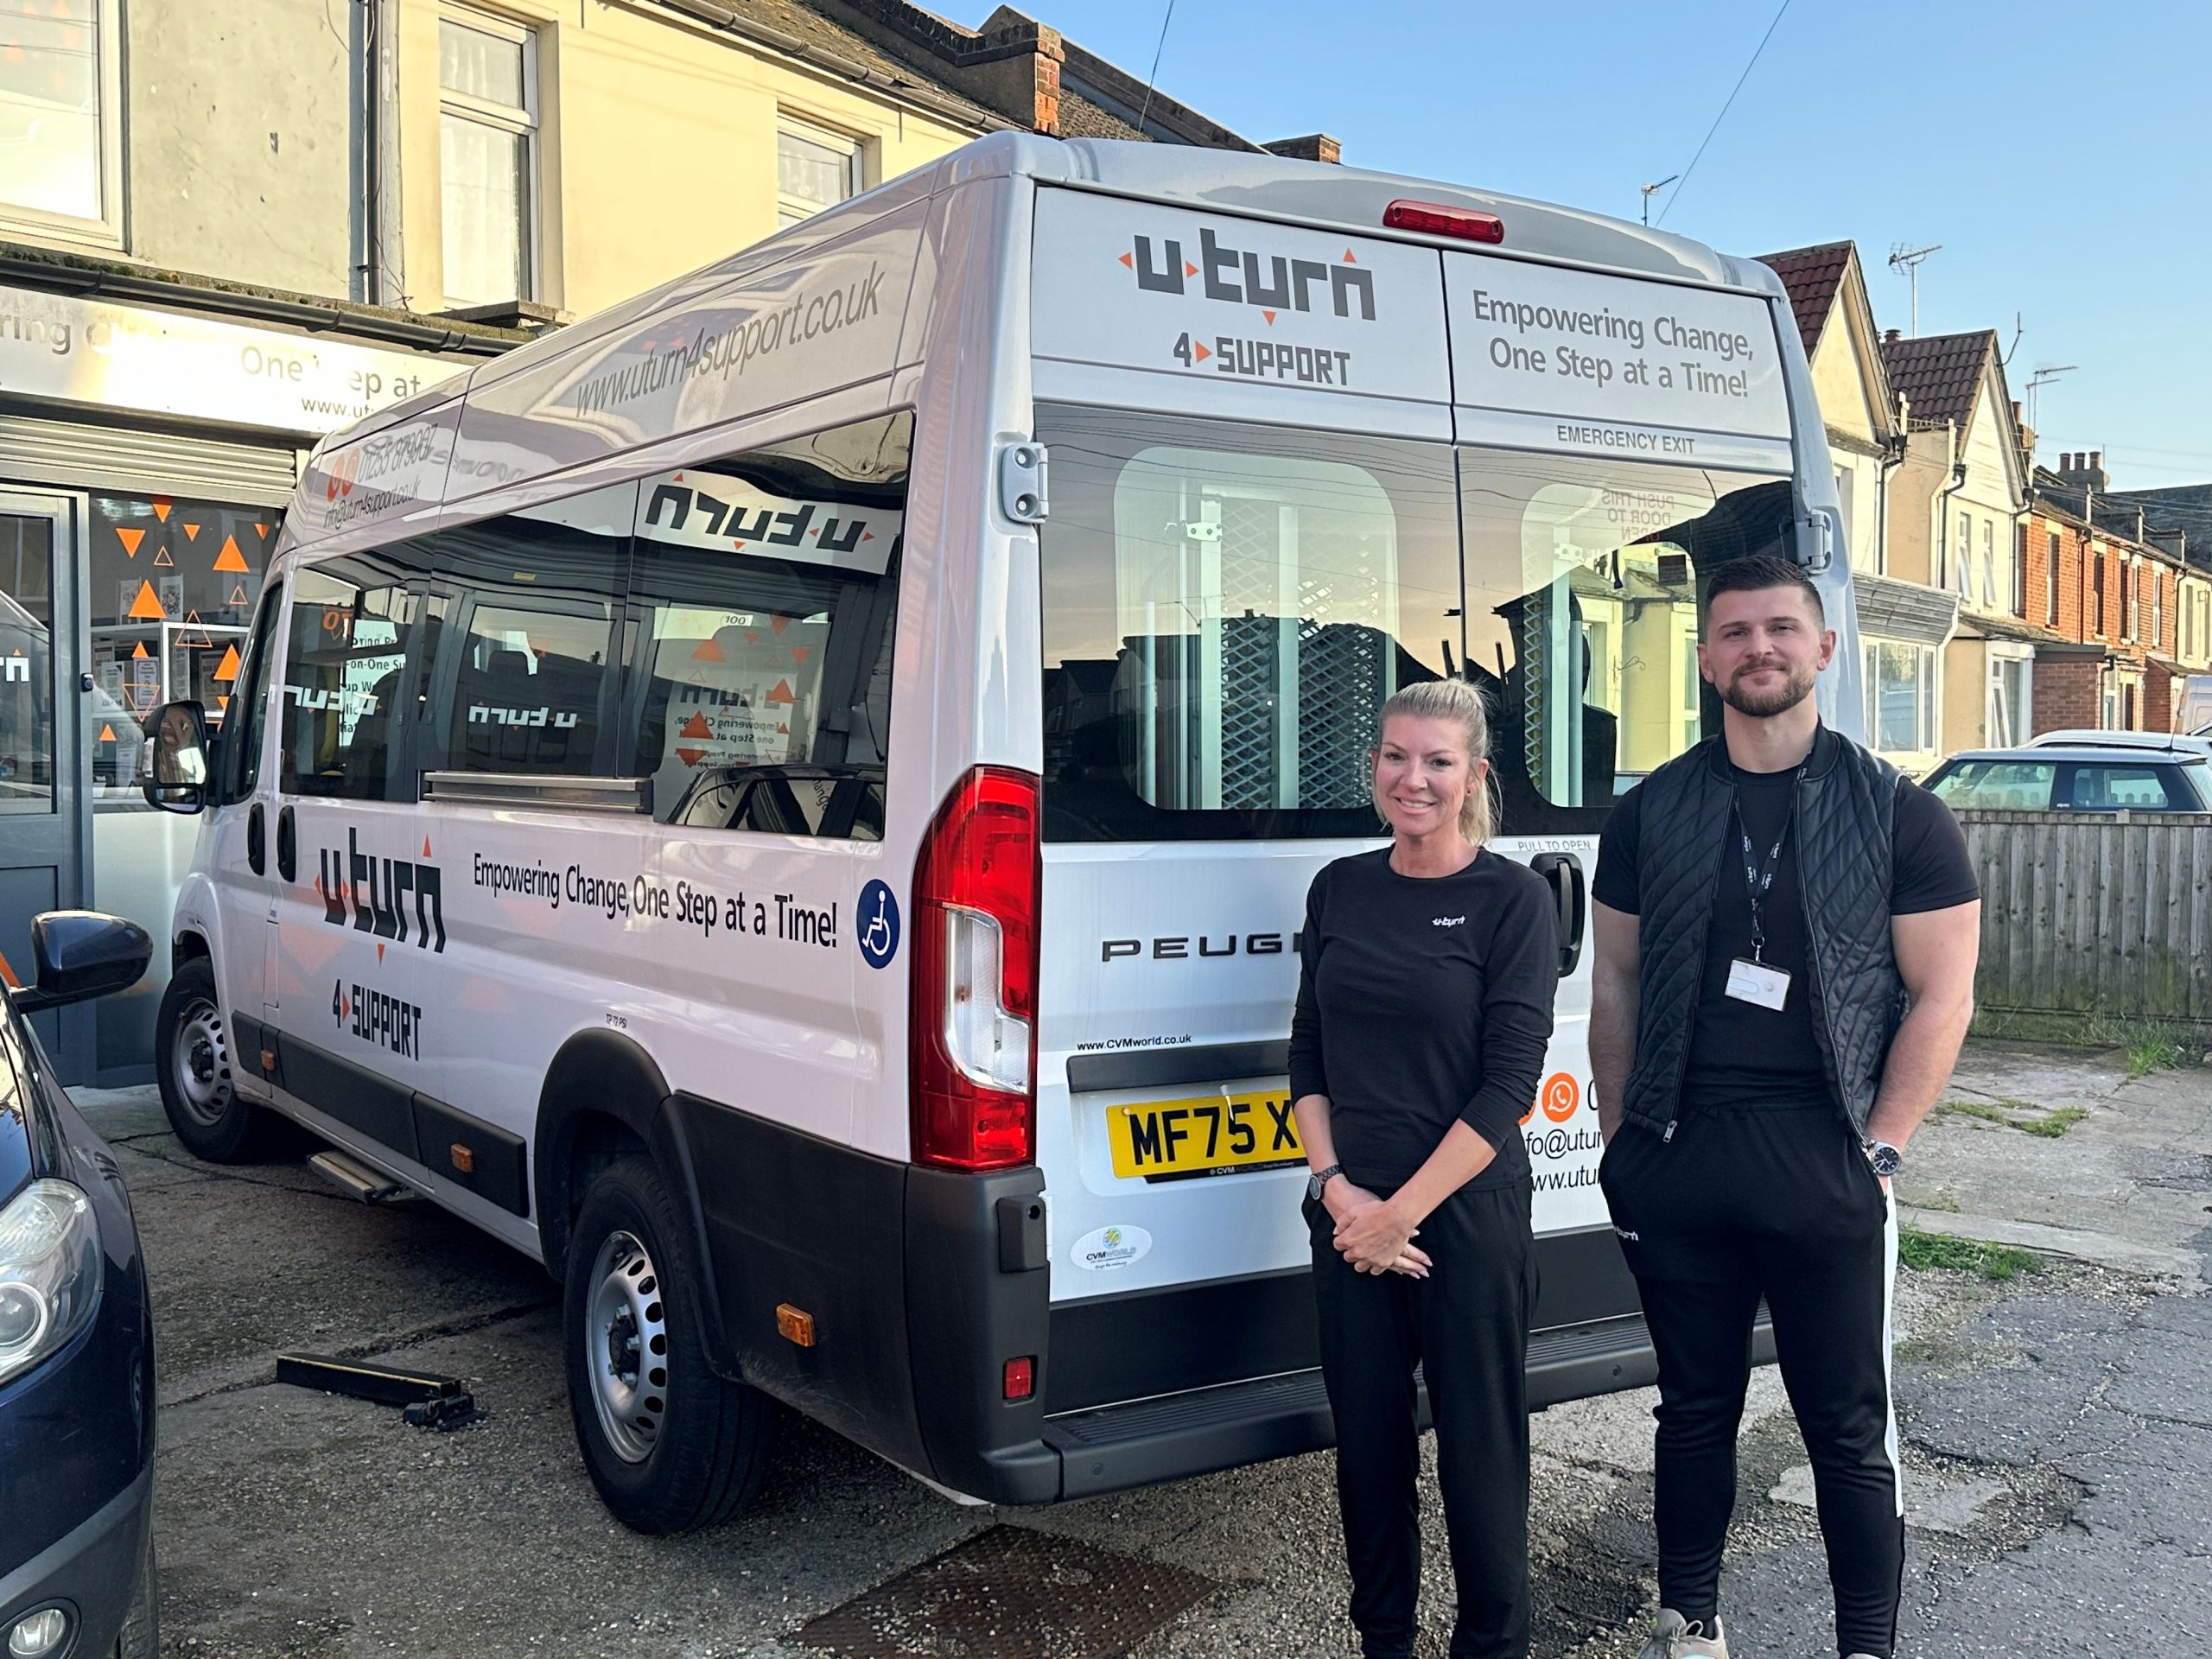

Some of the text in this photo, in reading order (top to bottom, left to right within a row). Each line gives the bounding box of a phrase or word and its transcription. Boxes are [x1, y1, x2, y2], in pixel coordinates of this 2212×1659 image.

[575, 260, 886, 418] www.uturn4support.co.uk
[1472, 289, 1754, 361] Empowering Change,
[240, 345, 303, 382] One
[1173, 332, 1351, 386] 4 SUPPORT
[1489, 336, 1749, 397] One Step at a Time!
[1557, 424, 1695, 454] EMERGENCY EXIT
[1517, 840, 1592, 852] PULL TO OPEN
[474, 852, 560, 909] Empowering
[677, 880, 717, 938] Step
[725, 891, 747, 932] at
[753, 902, 766, 936] a
[774, 893, 837, 948] Time!
[1102, 932, 1302, 963] PEUG
[333, 978, 422, 1062] 4 SUPPORT
[1077, 1033, 1192, 1052] www.CVMworld.co.uk
[1128, 1103, 1256, 1166] MF75
